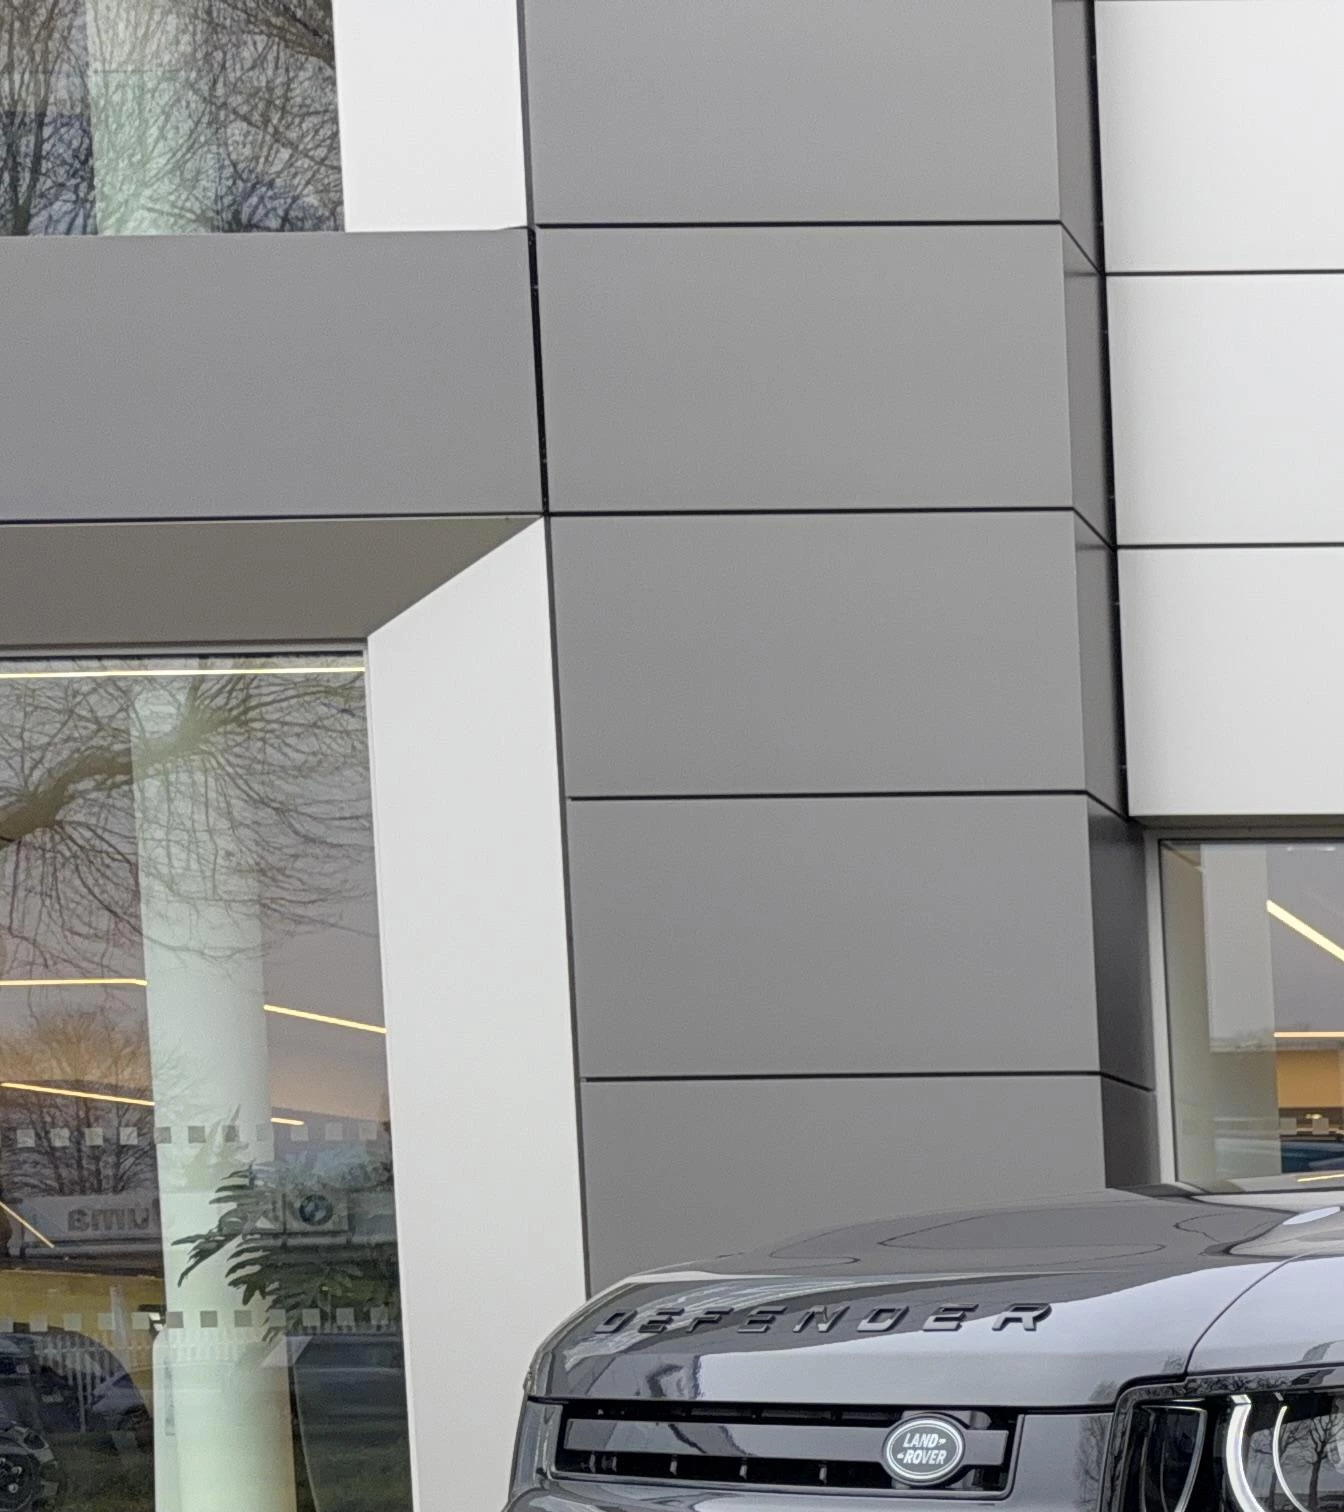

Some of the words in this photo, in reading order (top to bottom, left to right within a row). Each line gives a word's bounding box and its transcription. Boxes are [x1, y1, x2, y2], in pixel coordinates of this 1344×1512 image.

[594, 1302, 1052, 1335] DEFENDER
[902, 1432, 939, 1448] LAND
[903, 1449, 947, 1465] ROVER
